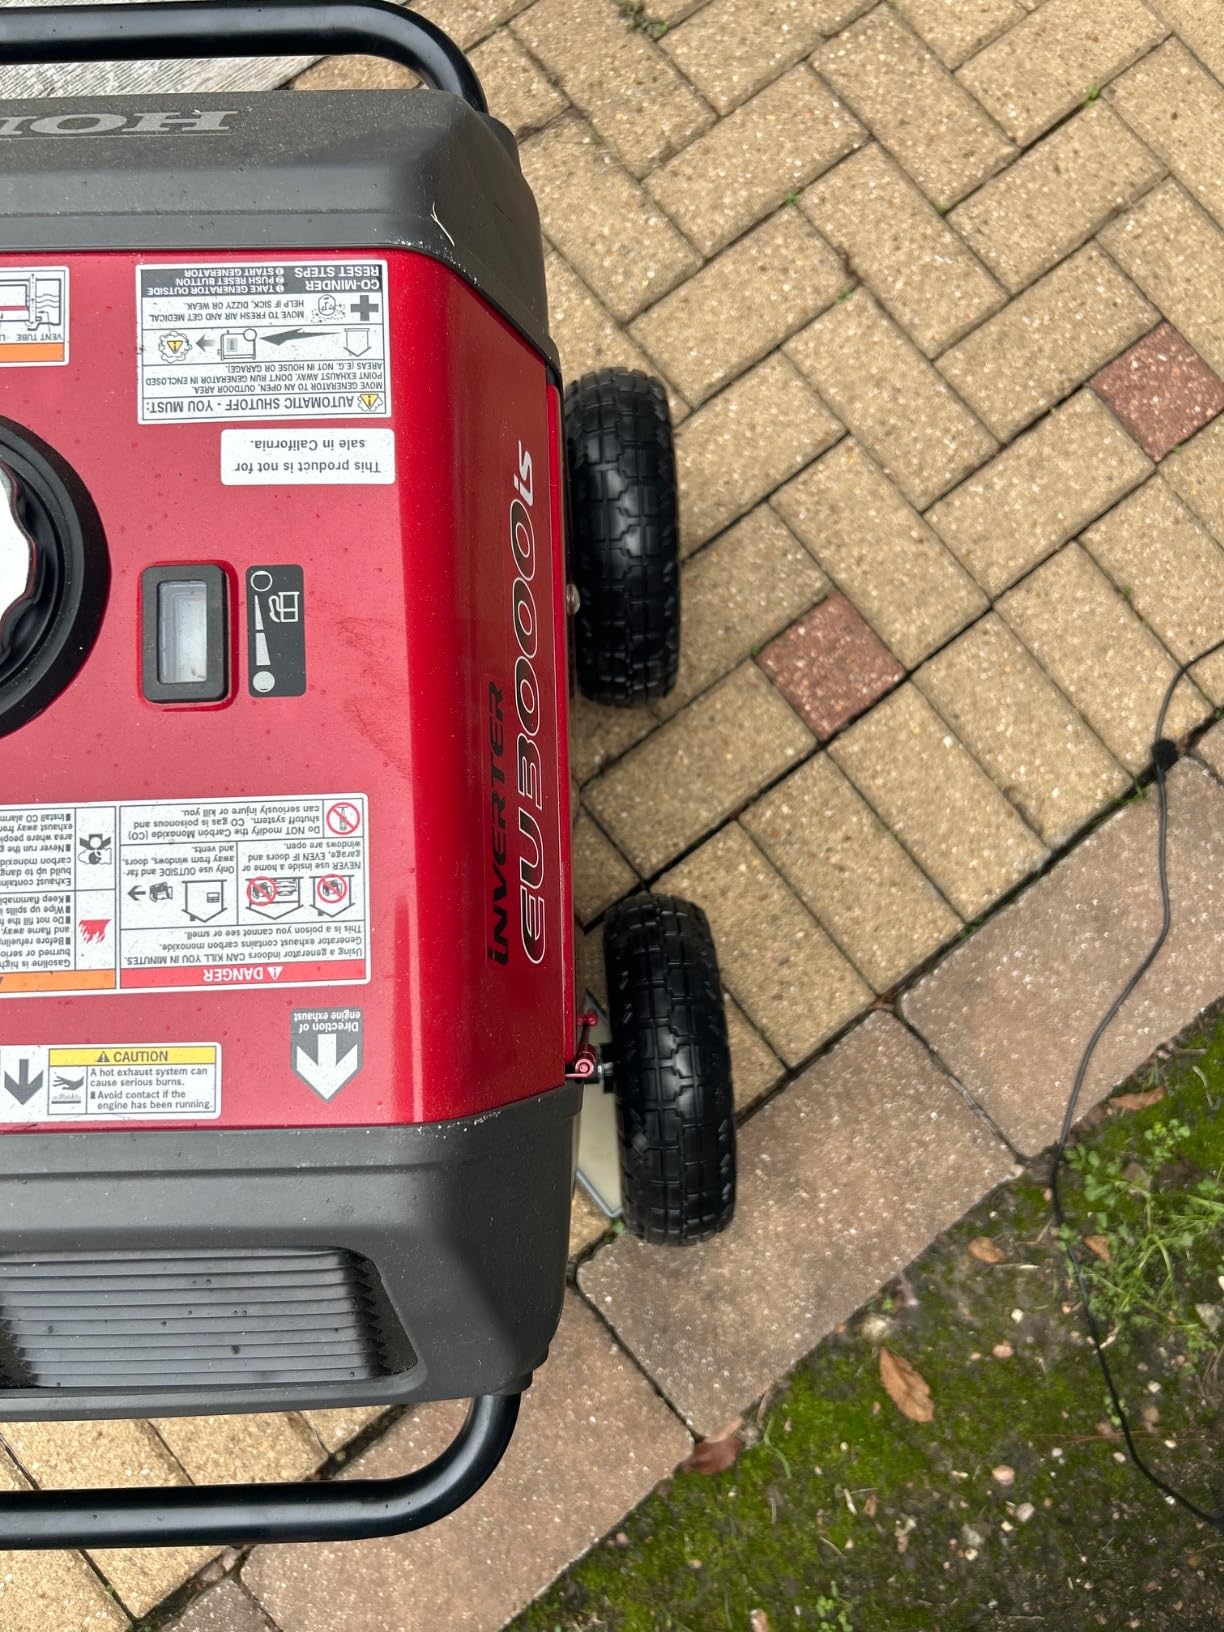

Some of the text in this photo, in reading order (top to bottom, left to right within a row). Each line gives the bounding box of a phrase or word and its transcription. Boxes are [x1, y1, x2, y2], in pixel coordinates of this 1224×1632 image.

[184, 269, 241, 277] GENERATOR
[295, 266, 379, 277] RESET STEPS
[305, 280, 380, 290] CO-MINDER
[148, 287, 188, 295] OUTSIDE
[191, 286, 248, 294] GENERATOR
[184, 302, 209, 310] WEAK.
[226, 301, 248, 309] DIZZY
[284, 300, 304, 308] HELP
[149, 311, 304, 322] MOVE FRESH AIR AND GET MEDICAL
[278, 364, 304, 372] HOUSE
[317, 363, 333, 371] NOT
[357, 362, 382, 370] AREAS
[201, 376, 247, 384] GENERATOR
[269, 374, 292, 382] DON'T
[321, 373, 356, 381] EXHAUST
[359, 372, 382, 380] POINT
[146, 377, 187, 385] ENCLOSED
[218, 385, 255, 393] OUTDOOR
[311, 382, 357, 390] GENERATOR
[146, 396, 354, 412] AUTOMATIC SHUTOFF YOU MUST:
[250, 440, 365, 451] sale California.
[234, 460, 381, 473] This product not for
[232, 806, 256, 815] injure
[260, 805, 300, 814] seriously
[154, 818, 198, 828] poisonous
[212, 817, 227, 825] gas
[251, 815, 285, 825] system.
[289, 816, 320, 824] shutoff
[17, 823, 72, 832] exhaust away
[252, 826, 282, 835] modify
[128, 830, 148, 839] (CO)
[152, 830, 194, 838] Monoxide
[198, 829, 231, 837] Carbon
[234, 828, 248, 836] the
[27, 835, 51, 843] where
[284, 841, 306, 849] open.
[213, 854, 234, 862] away
[303, 852, 325, 860] EVEN
[329, 850, 360, 858] garage,
[40, 858, 71, 866] carbon
[191, 856, 210, 864] from
[50, 868, 71, 876] build
[141, 868, 156, 876] and
[160, 867, 195, 876] OUTSIDE
[216, 864, 234, 874] Only
[37, 878, 71, 887] Exhaust
[43, 894, 64, 904] Keep
[6, 904, 64, 915] Wipe spills
[1, 926, 24, 934] away.
[54, 927, 70, 935] and
[243, 928, 273, 936] cannot
[295, 925, 322, 934] poison
[344, 925, 361, 933] This
[184, 930, 209, 938] smell.
[160, 937, 361, 950] Generator exhaust contains carbon monoxide.
[38, 949, 70, 957] burned
[124, 946, 362, 964] Using generator indoors CAN KILL YOU MINUTES.
[32, 960, 70, 968] Gasoline
[204, 967, 263, 980] DANGER
[294, 1010, 360, 1022] engine exhaust
[313, 1022, 358, 1033] Direction
[114, 1051, 168, 1062] CAUTION
[100, 1069, 114, 1077] hot
[118, 1068, 152, 1077] exhaust
[156, 1068, 187, 1078] system
[121, 1079, 152, 1087] serious
[156, 1078, 184, 1086] burns.
[98, 1090, 186, 1100] Avoid contact the
[98, 1100, 212, 1111] engine has been running.
